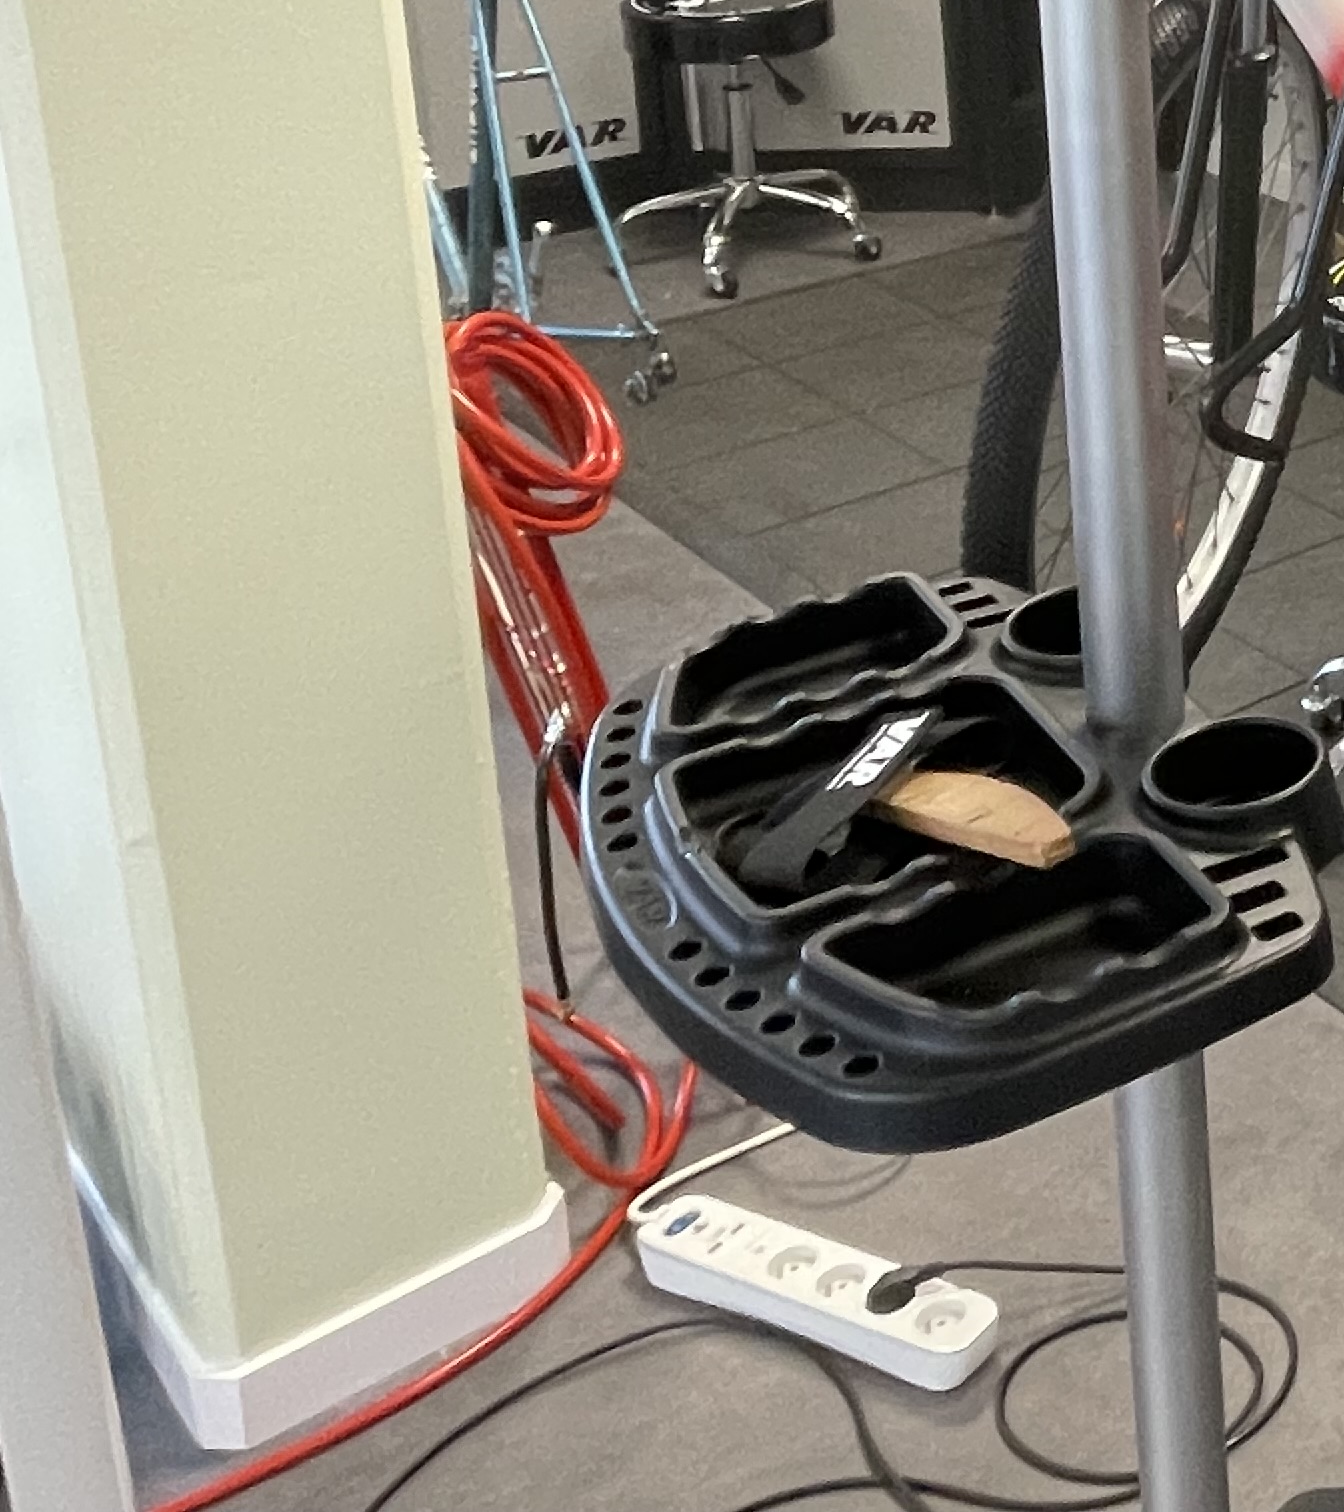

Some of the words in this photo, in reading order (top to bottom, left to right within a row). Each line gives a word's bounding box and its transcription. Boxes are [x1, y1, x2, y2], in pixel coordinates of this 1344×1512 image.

[518, 118, 626, 159] VAR
[838, 110, 938, 135] VAR
[835, 710, 932, 788] VAR
